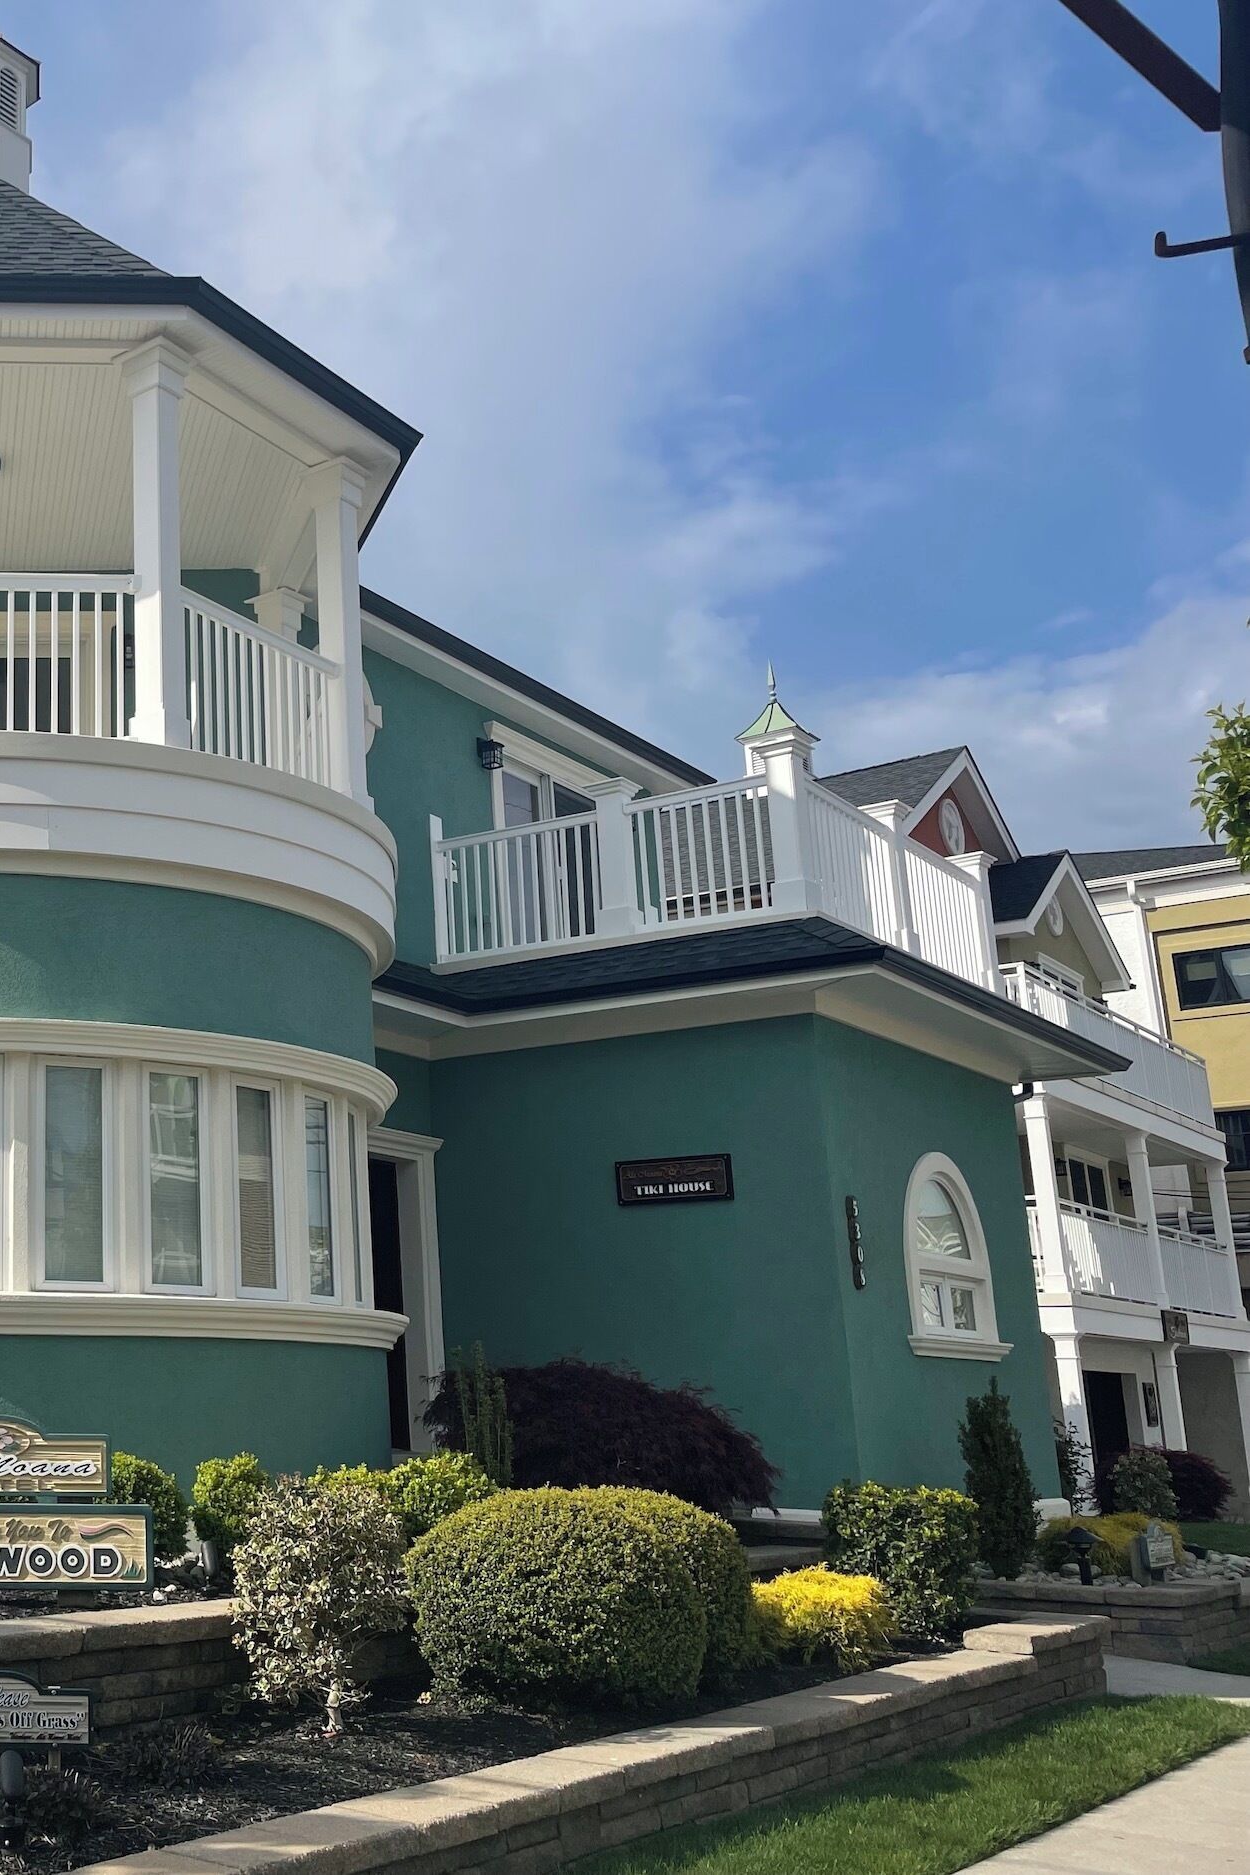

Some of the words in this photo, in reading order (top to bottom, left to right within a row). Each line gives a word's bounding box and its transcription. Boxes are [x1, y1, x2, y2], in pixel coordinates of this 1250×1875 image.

[634, 1184, 664, 1196] TIKI
[668, 1181, 715, 1193] HOUSE
[5, 1518, 41, 1543] You
[47, 1517, 74, 1543] To
[9, 1711, 33, 1729] Off
